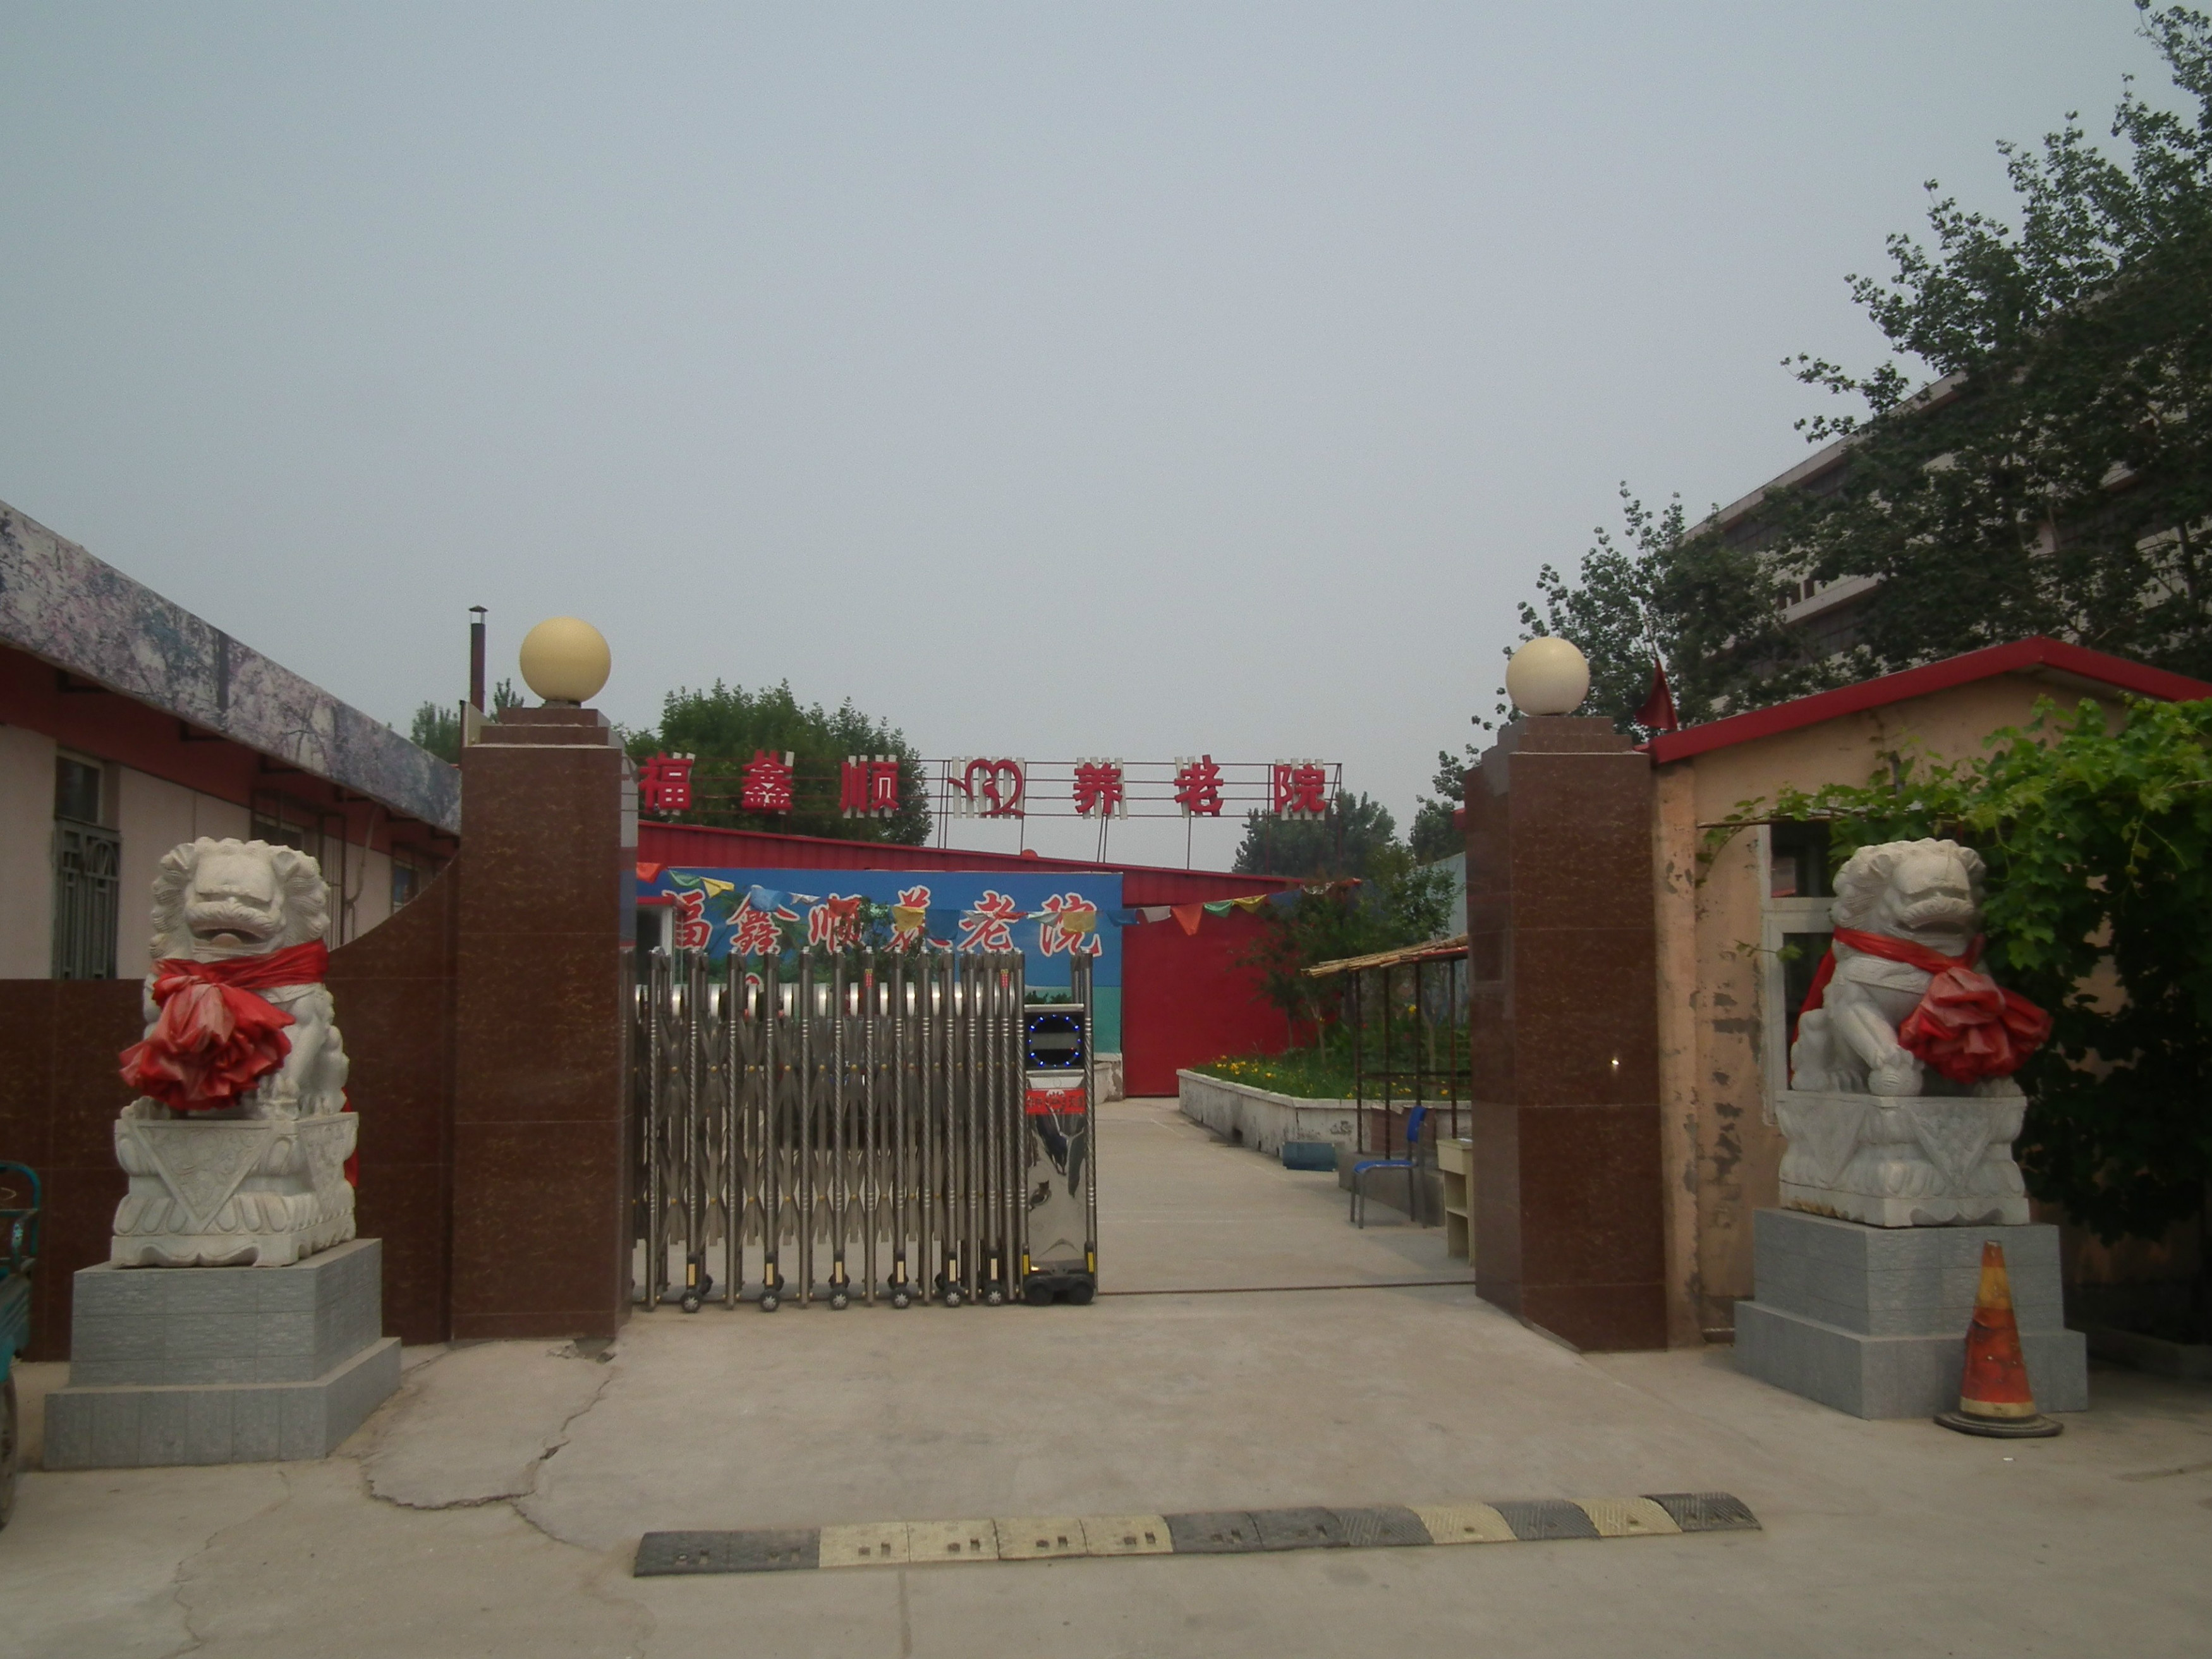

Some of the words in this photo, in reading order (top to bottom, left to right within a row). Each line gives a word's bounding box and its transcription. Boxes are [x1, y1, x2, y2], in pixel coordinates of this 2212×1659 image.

[638, 750, 899, 814] 福鑫顺
[1073, 755, 1327, 817] 养老院
